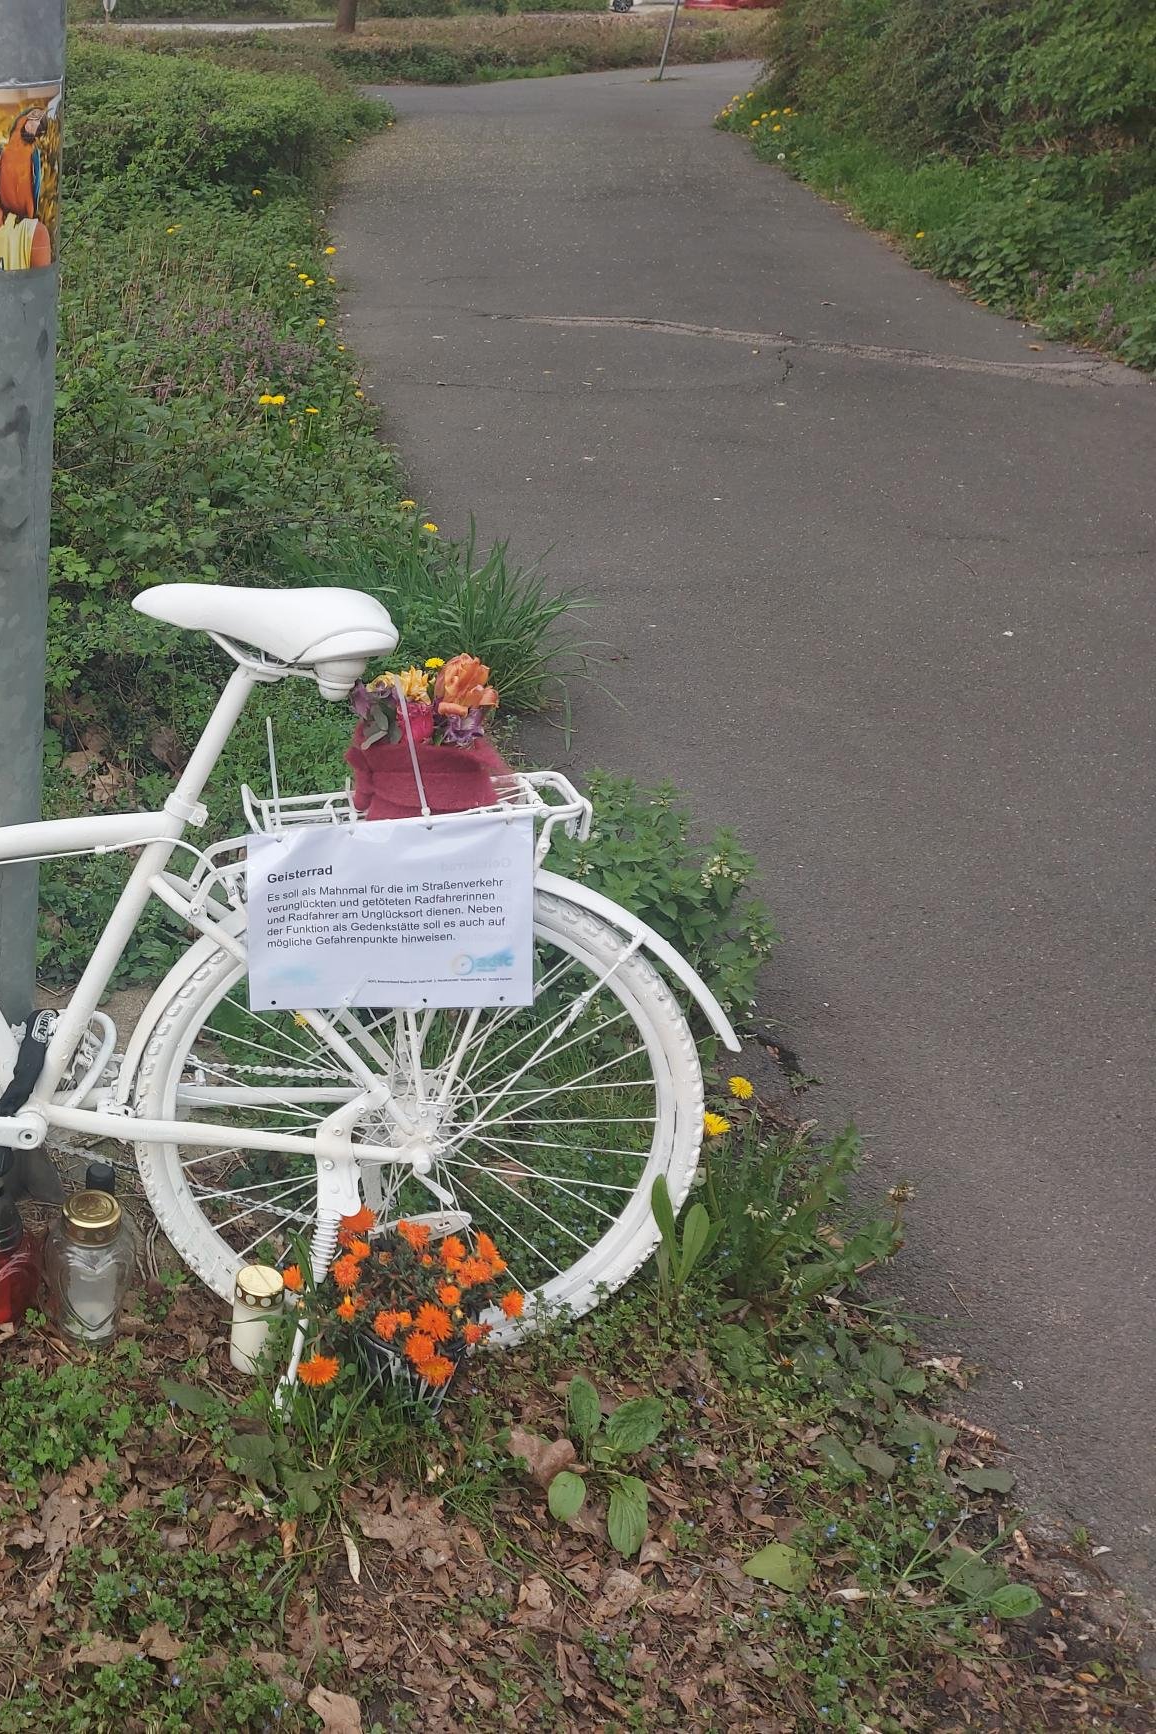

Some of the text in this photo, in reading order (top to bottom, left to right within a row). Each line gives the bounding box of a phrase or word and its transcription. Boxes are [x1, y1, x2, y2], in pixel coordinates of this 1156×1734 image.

[267, 865, 332, 884] Geisterrad
[267, 878, 503, 901] Es soll als Mahnmal für die im Straßenverkehr
[267, 892, 495, 913] verunglückten und getöteten Radfahrerinnen
[267, 915, 285, 924] und
[288, 911, 339, 921] Radfahrer
[362, 908, 422, 920] Unglücksort
[426, 907, 463, 916] dienen.
[468, 904, 502, 913] Neben
[267, 917, 505, 935] der Funktion als Gedenkstätte soll es auch auf
[267, 933, 455, 948] mögliche Gefahrenpunkte hinweisen.
[38, 1011, 53, 1036] ABUS
